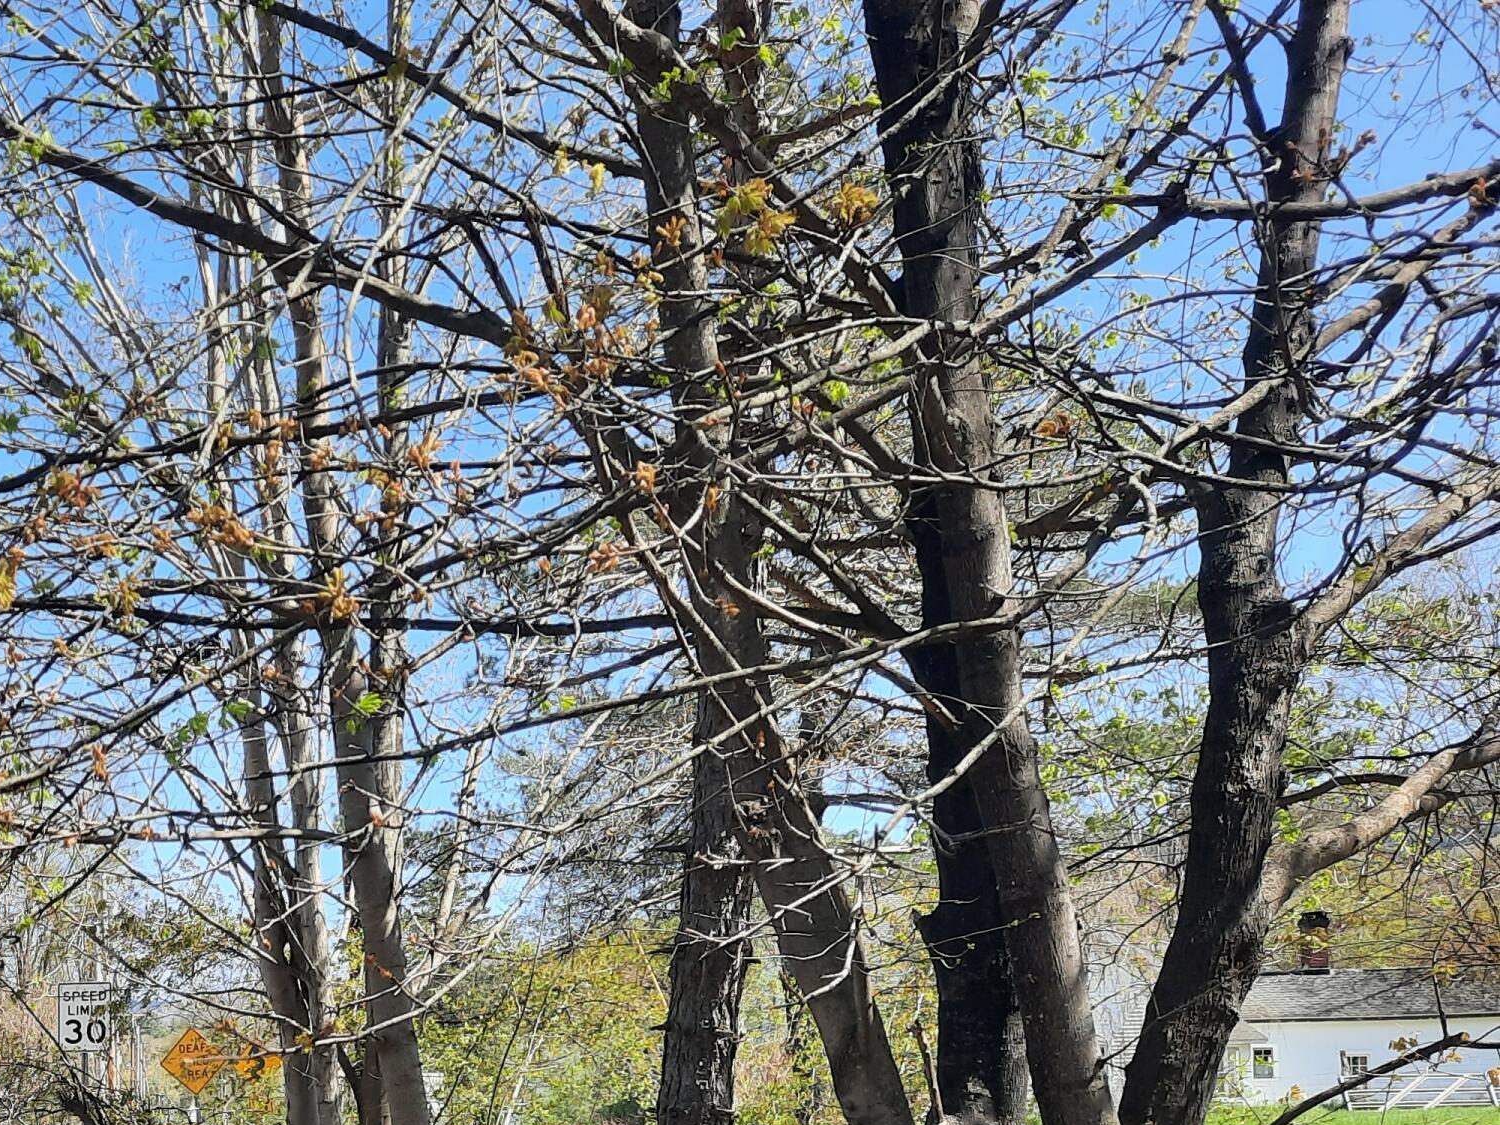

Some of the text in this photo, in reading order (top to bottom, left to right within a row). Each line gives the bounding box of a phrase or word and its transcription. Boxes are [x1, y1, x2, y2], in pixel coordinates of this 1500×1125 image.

[63, 991, 107, 1002] SPEED
[64, 1019, 106, 1044] 30
[178, 1042, 207, 1054] DEAF
